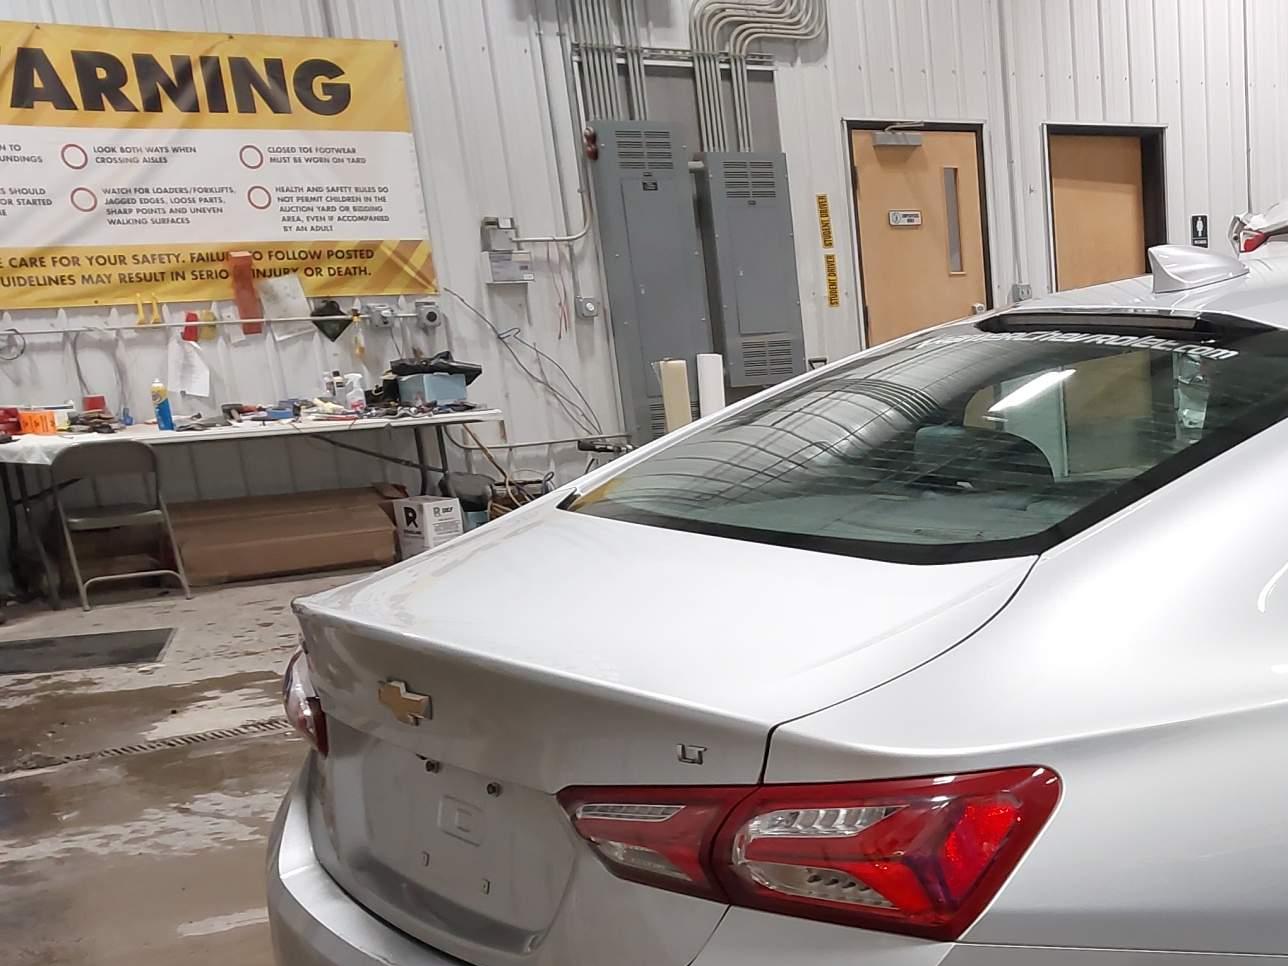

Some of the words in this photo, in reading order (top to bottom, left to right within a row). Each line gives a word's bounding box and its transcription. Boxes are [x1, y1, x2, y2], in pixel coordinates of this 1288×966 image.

[0, 46, 352, 116] ARNING
[0, 155, 43, 163] UNDINGS
[267, 146, 297, 154] CLOSED
[15, 198, 53, 206] STARTED
[817, 195, 829, 218] DRIVER
[150, 217, 190, 225] SURFACES
[820, 218, 832, 247] STUDENT
[8, 256, 46, 268] CARE
[51, 255, 81, 267] FOR
[85, 254, 127, 266] YOUR
[132, 252, 186, 265] SAFETY.
[268, 249, 322, 261] FOLLOW
[326, 249, 374, 260] POSTED
[826, 255, 837, 277] DRIVER
[0, 274, 76, 288] UIDELINES
[81, 273, 113, 285] MAY
[118, 271, 167, 284] RESULT
[170, 270, 186, 281] IN
[191, 269, 229, 281] SERIO
[304, 266, 324, 277] OR
[327, 265, 372, 277] DEATH.
[828, 278, 839, 305] STUDENT
[676, 743, 708, 765] LT
